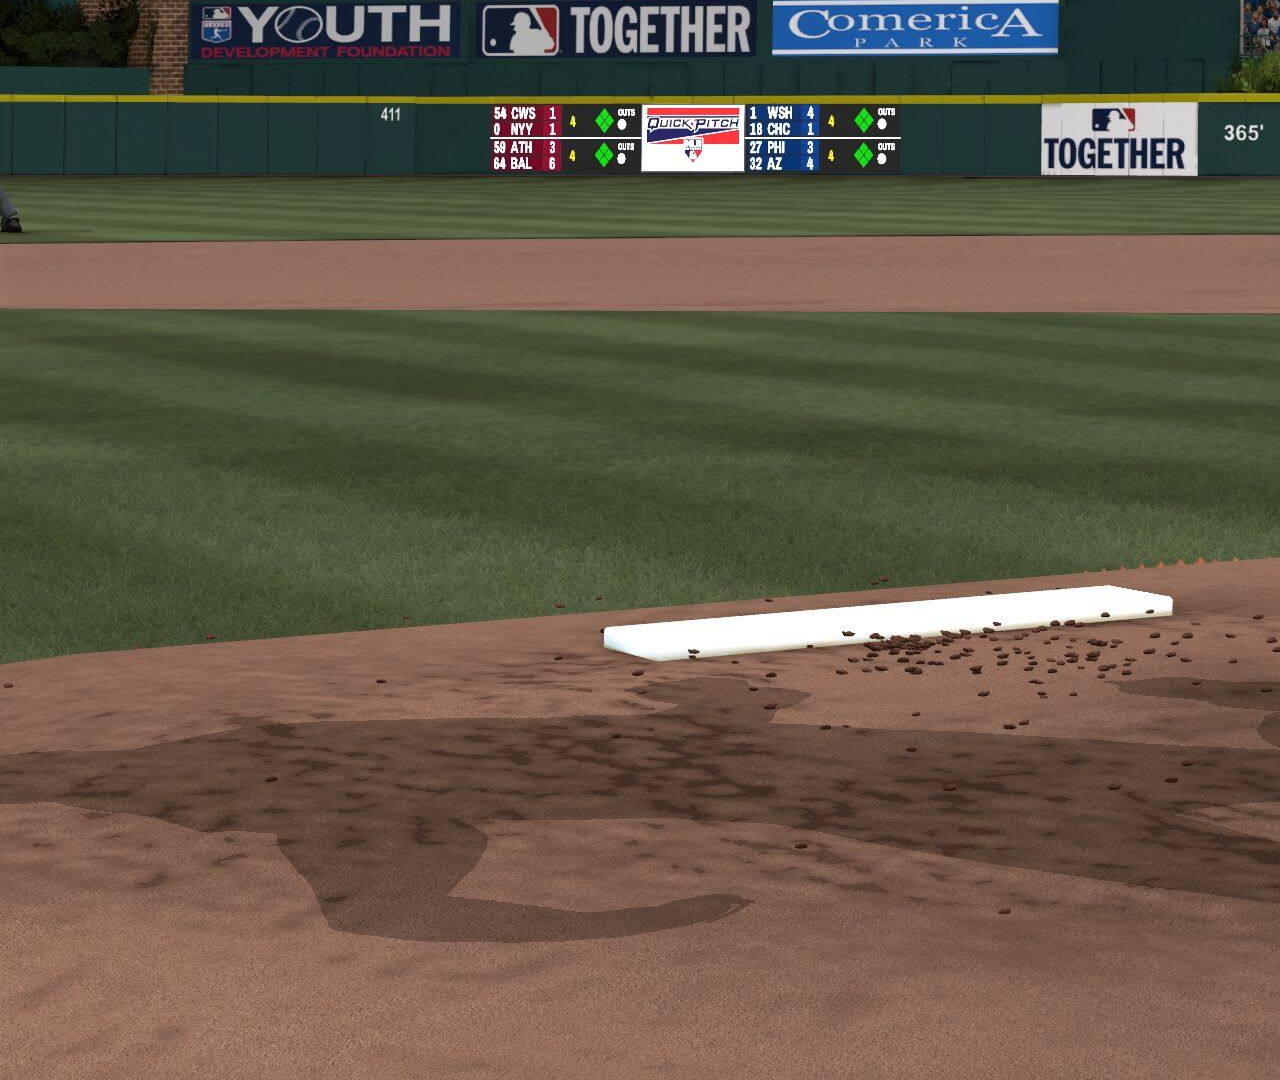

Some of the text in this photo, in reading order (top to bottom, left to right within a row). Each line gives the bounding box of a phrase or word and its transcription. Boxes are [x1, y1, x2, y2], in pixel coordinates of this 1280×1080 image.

[237, 5, 451, 43] YOUTH
[570, 5, 750, 53] TOGETHER
[855, 37, 968, 47] PARK
[201, 45, 450, 59] DEVELOPMENT FOUNDATION
[380, 107, 401, 122] 411
[493, 107, 556, 120] 54 CWS 1
[618, 108, 635, 117] OUTS
[750, 107, 814, 119] 1 WSH 4
[877, 108, 896, 116] OUTS
[569, 115, 576, 128] 4
[648, 118, 739, 131] QUICK PITCH
[828, 115, 835, 128] 4
[493, 123, 556, 136] 0 NYY 1
[767, 123, 791, 136] CHC
[807, 123, 814, 136] 1
[1224, 124, 1264, 141] 365'
[510, 141, 533, 154] ATH
[549, 141, 555, 154] 3
[618, 143, 635, 151] OUTS
[749, 141, 814, 154] 27 PHI 3
[877, 143, 896, 151] OUTS
[1044, 137, 1185, 169] TOGETHER
[569, 150, 576, 162] 4
[827, 150, 835, 162] 4
[493, 157, 555, 170] 64 BAL 6
[749, 157, 814, 170] 32 AZ 4
